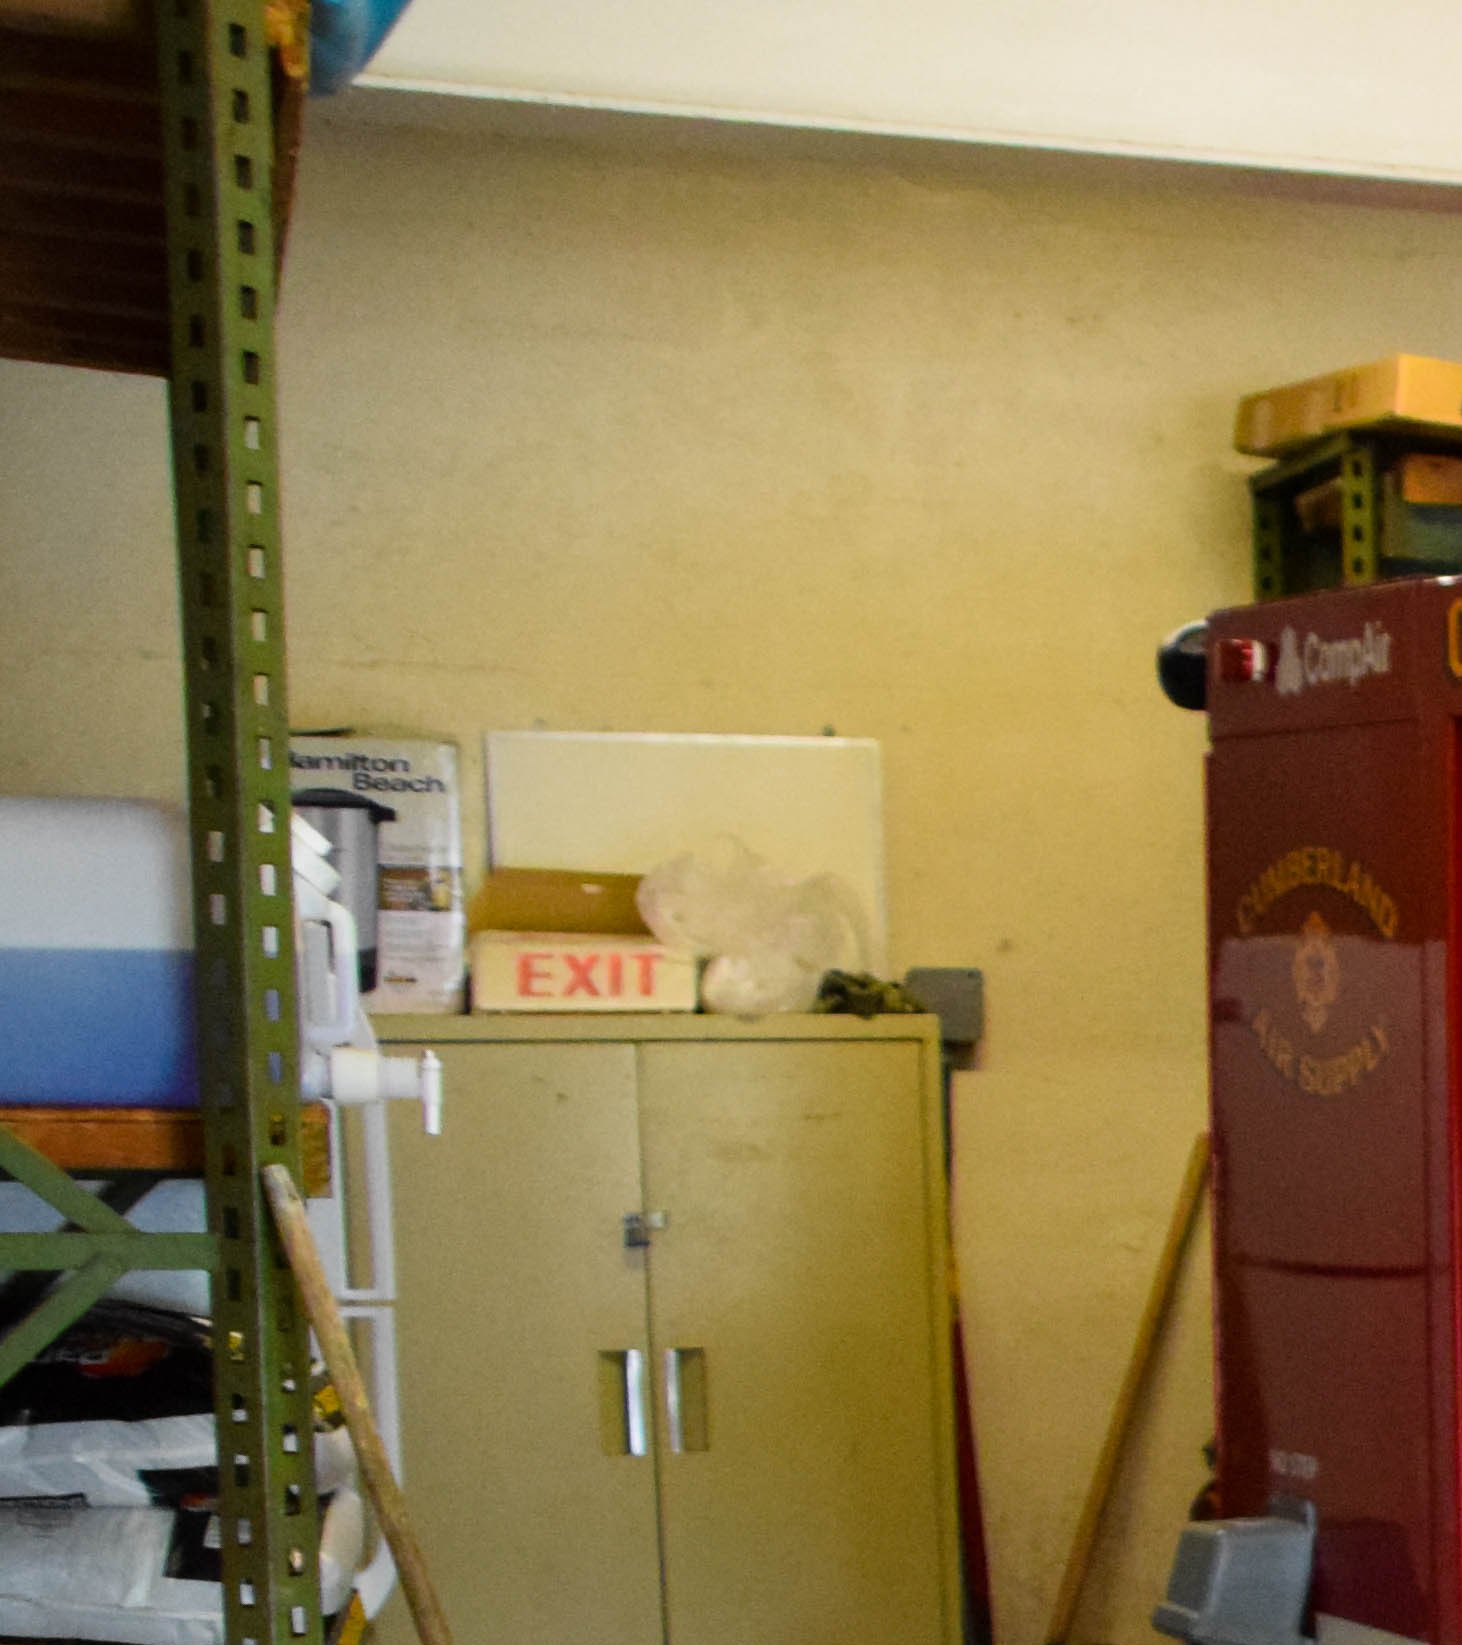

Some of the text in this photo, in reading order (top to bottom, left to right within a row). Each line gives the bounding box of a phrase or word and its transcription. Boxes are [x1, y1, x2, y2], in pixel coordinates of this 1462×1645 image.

[290, 751, 410, 774] amilton
[352, 772, 446, 793] Beach
[516, 953, 664, 997] EXIT
